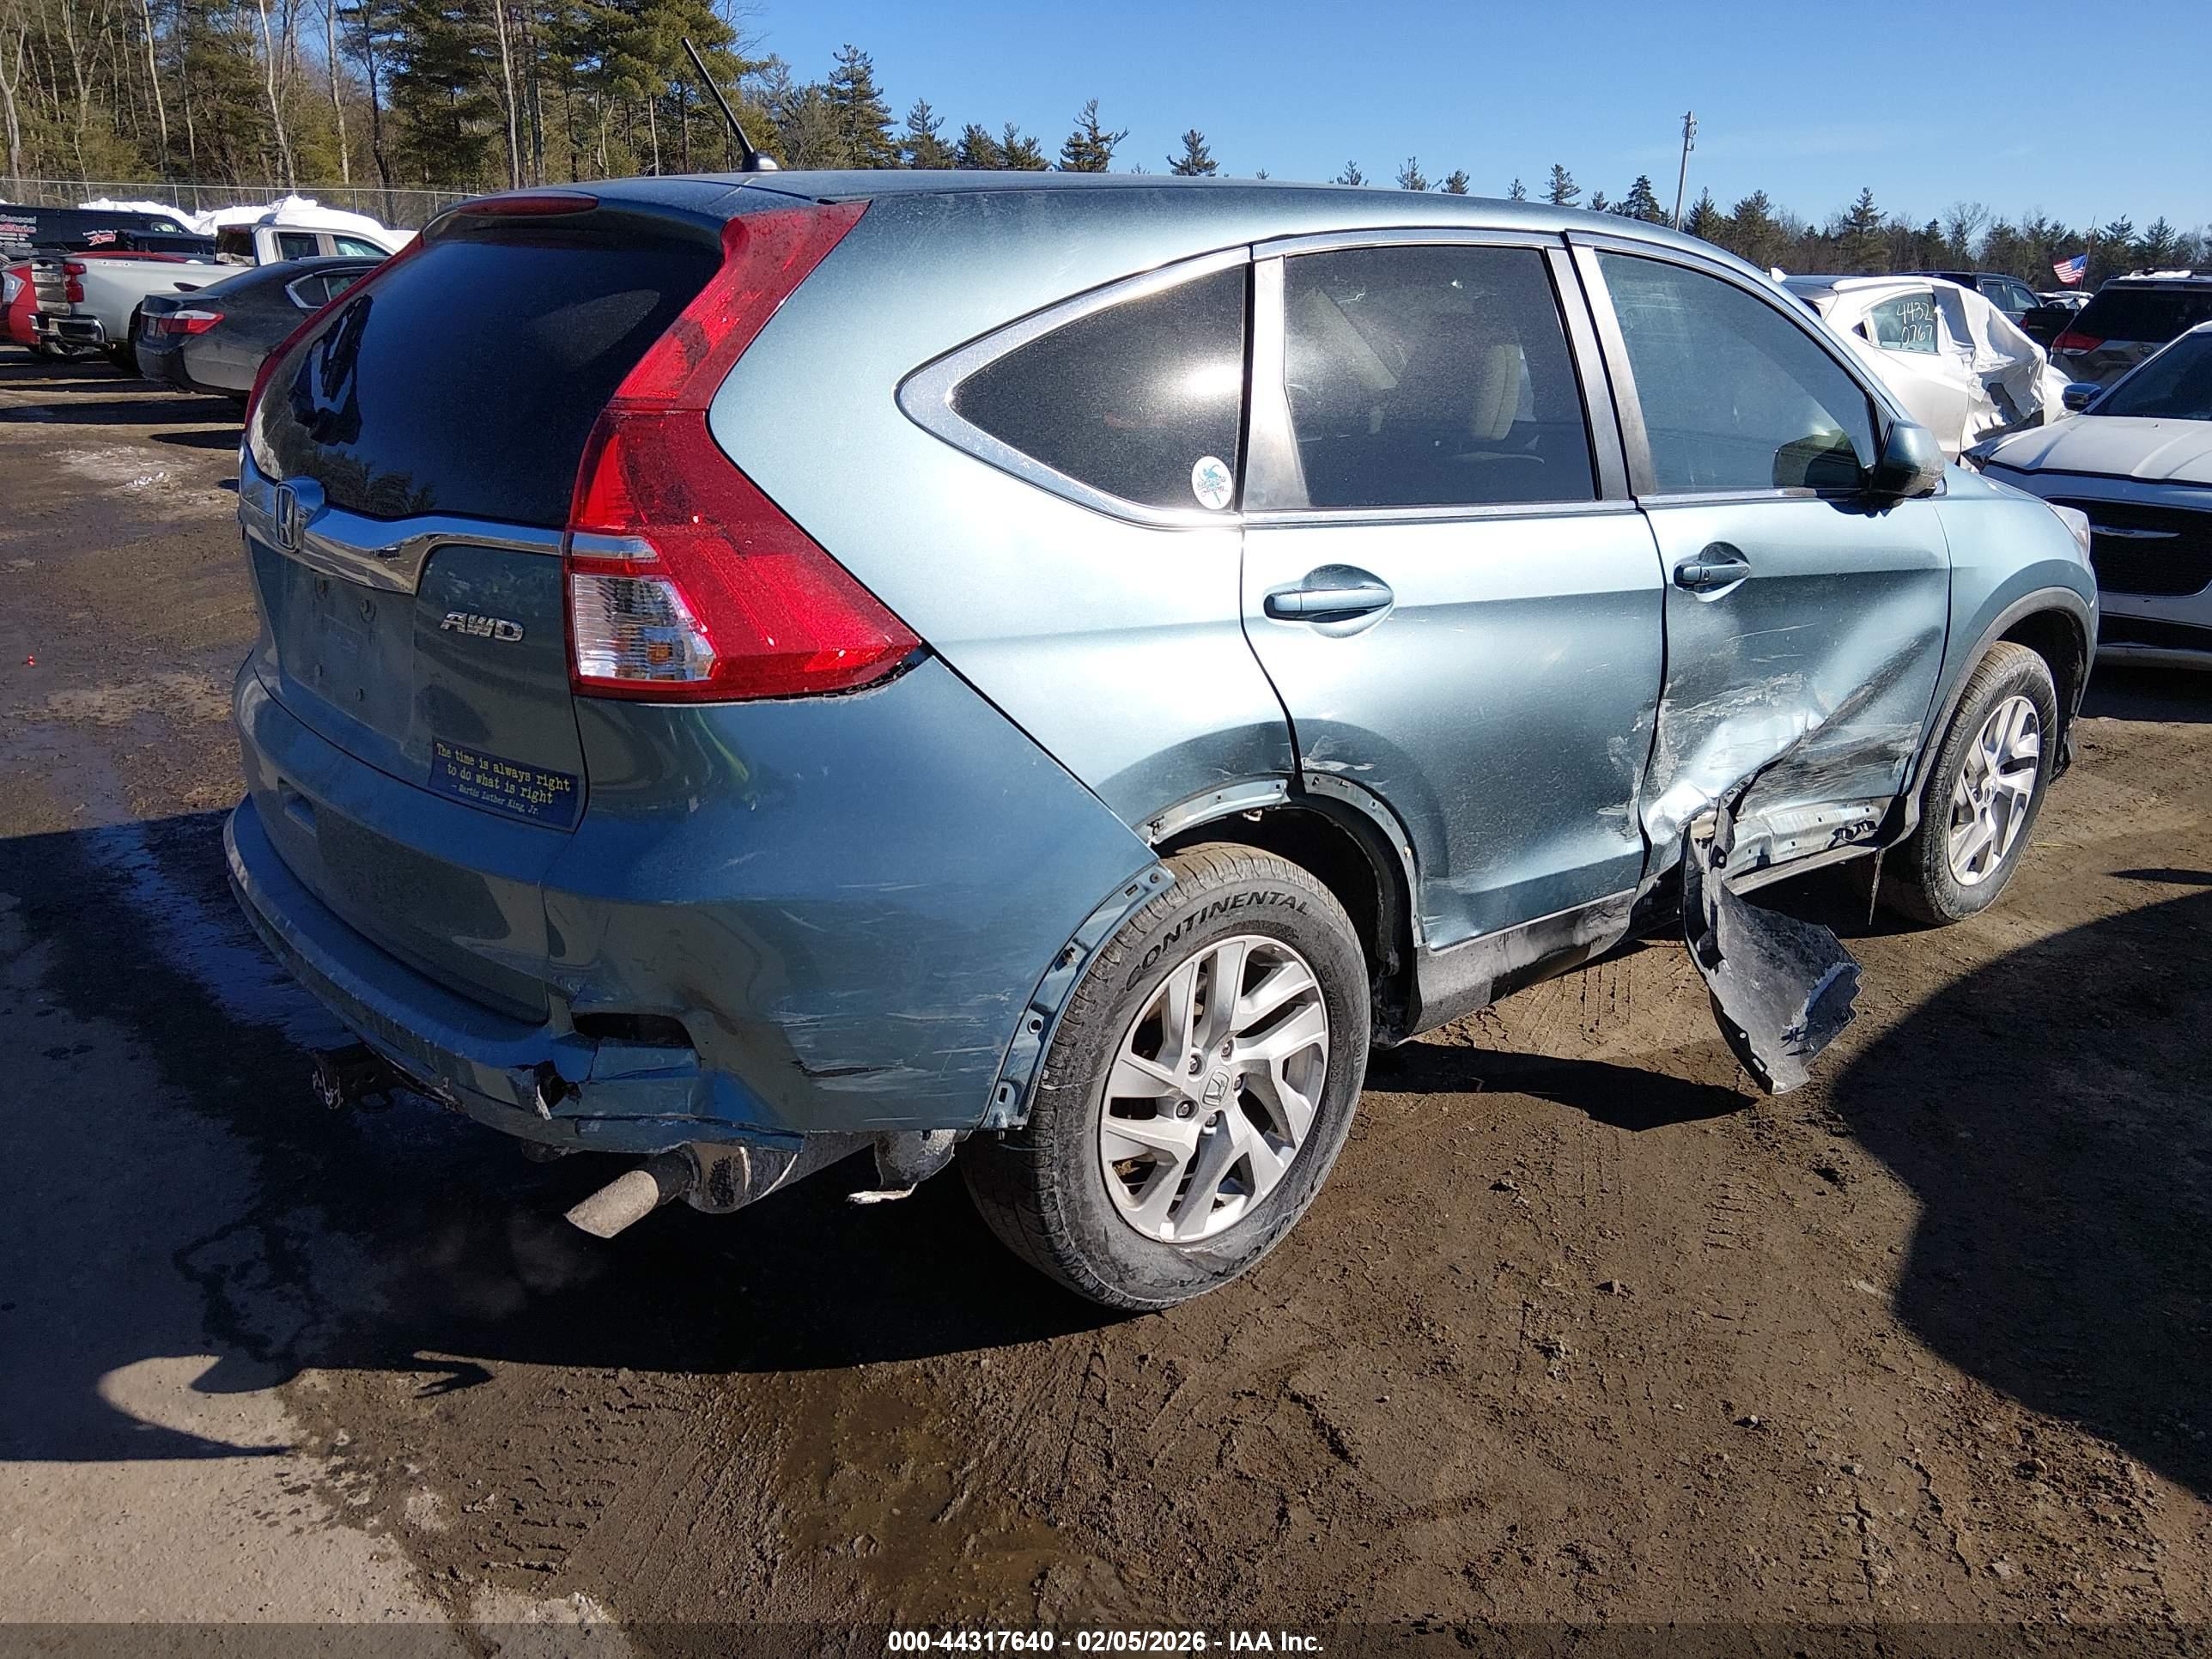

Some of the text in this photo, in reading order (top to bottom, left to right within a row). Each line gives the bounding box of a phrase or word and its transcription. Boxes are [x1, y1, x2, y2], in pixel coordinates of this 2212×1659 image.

[1896, 301, 1934, 325] 4432
[1901, 323, 1933, 344] 0767
[441, 611, 524, 642] AWD
[436, 742, 571, 792] The time is always right
[447, 763, 553, 805] to do what is right
[481, 791, 505, 805] Luther
[1127, 890, 1308, 992] CONTINENTAL
